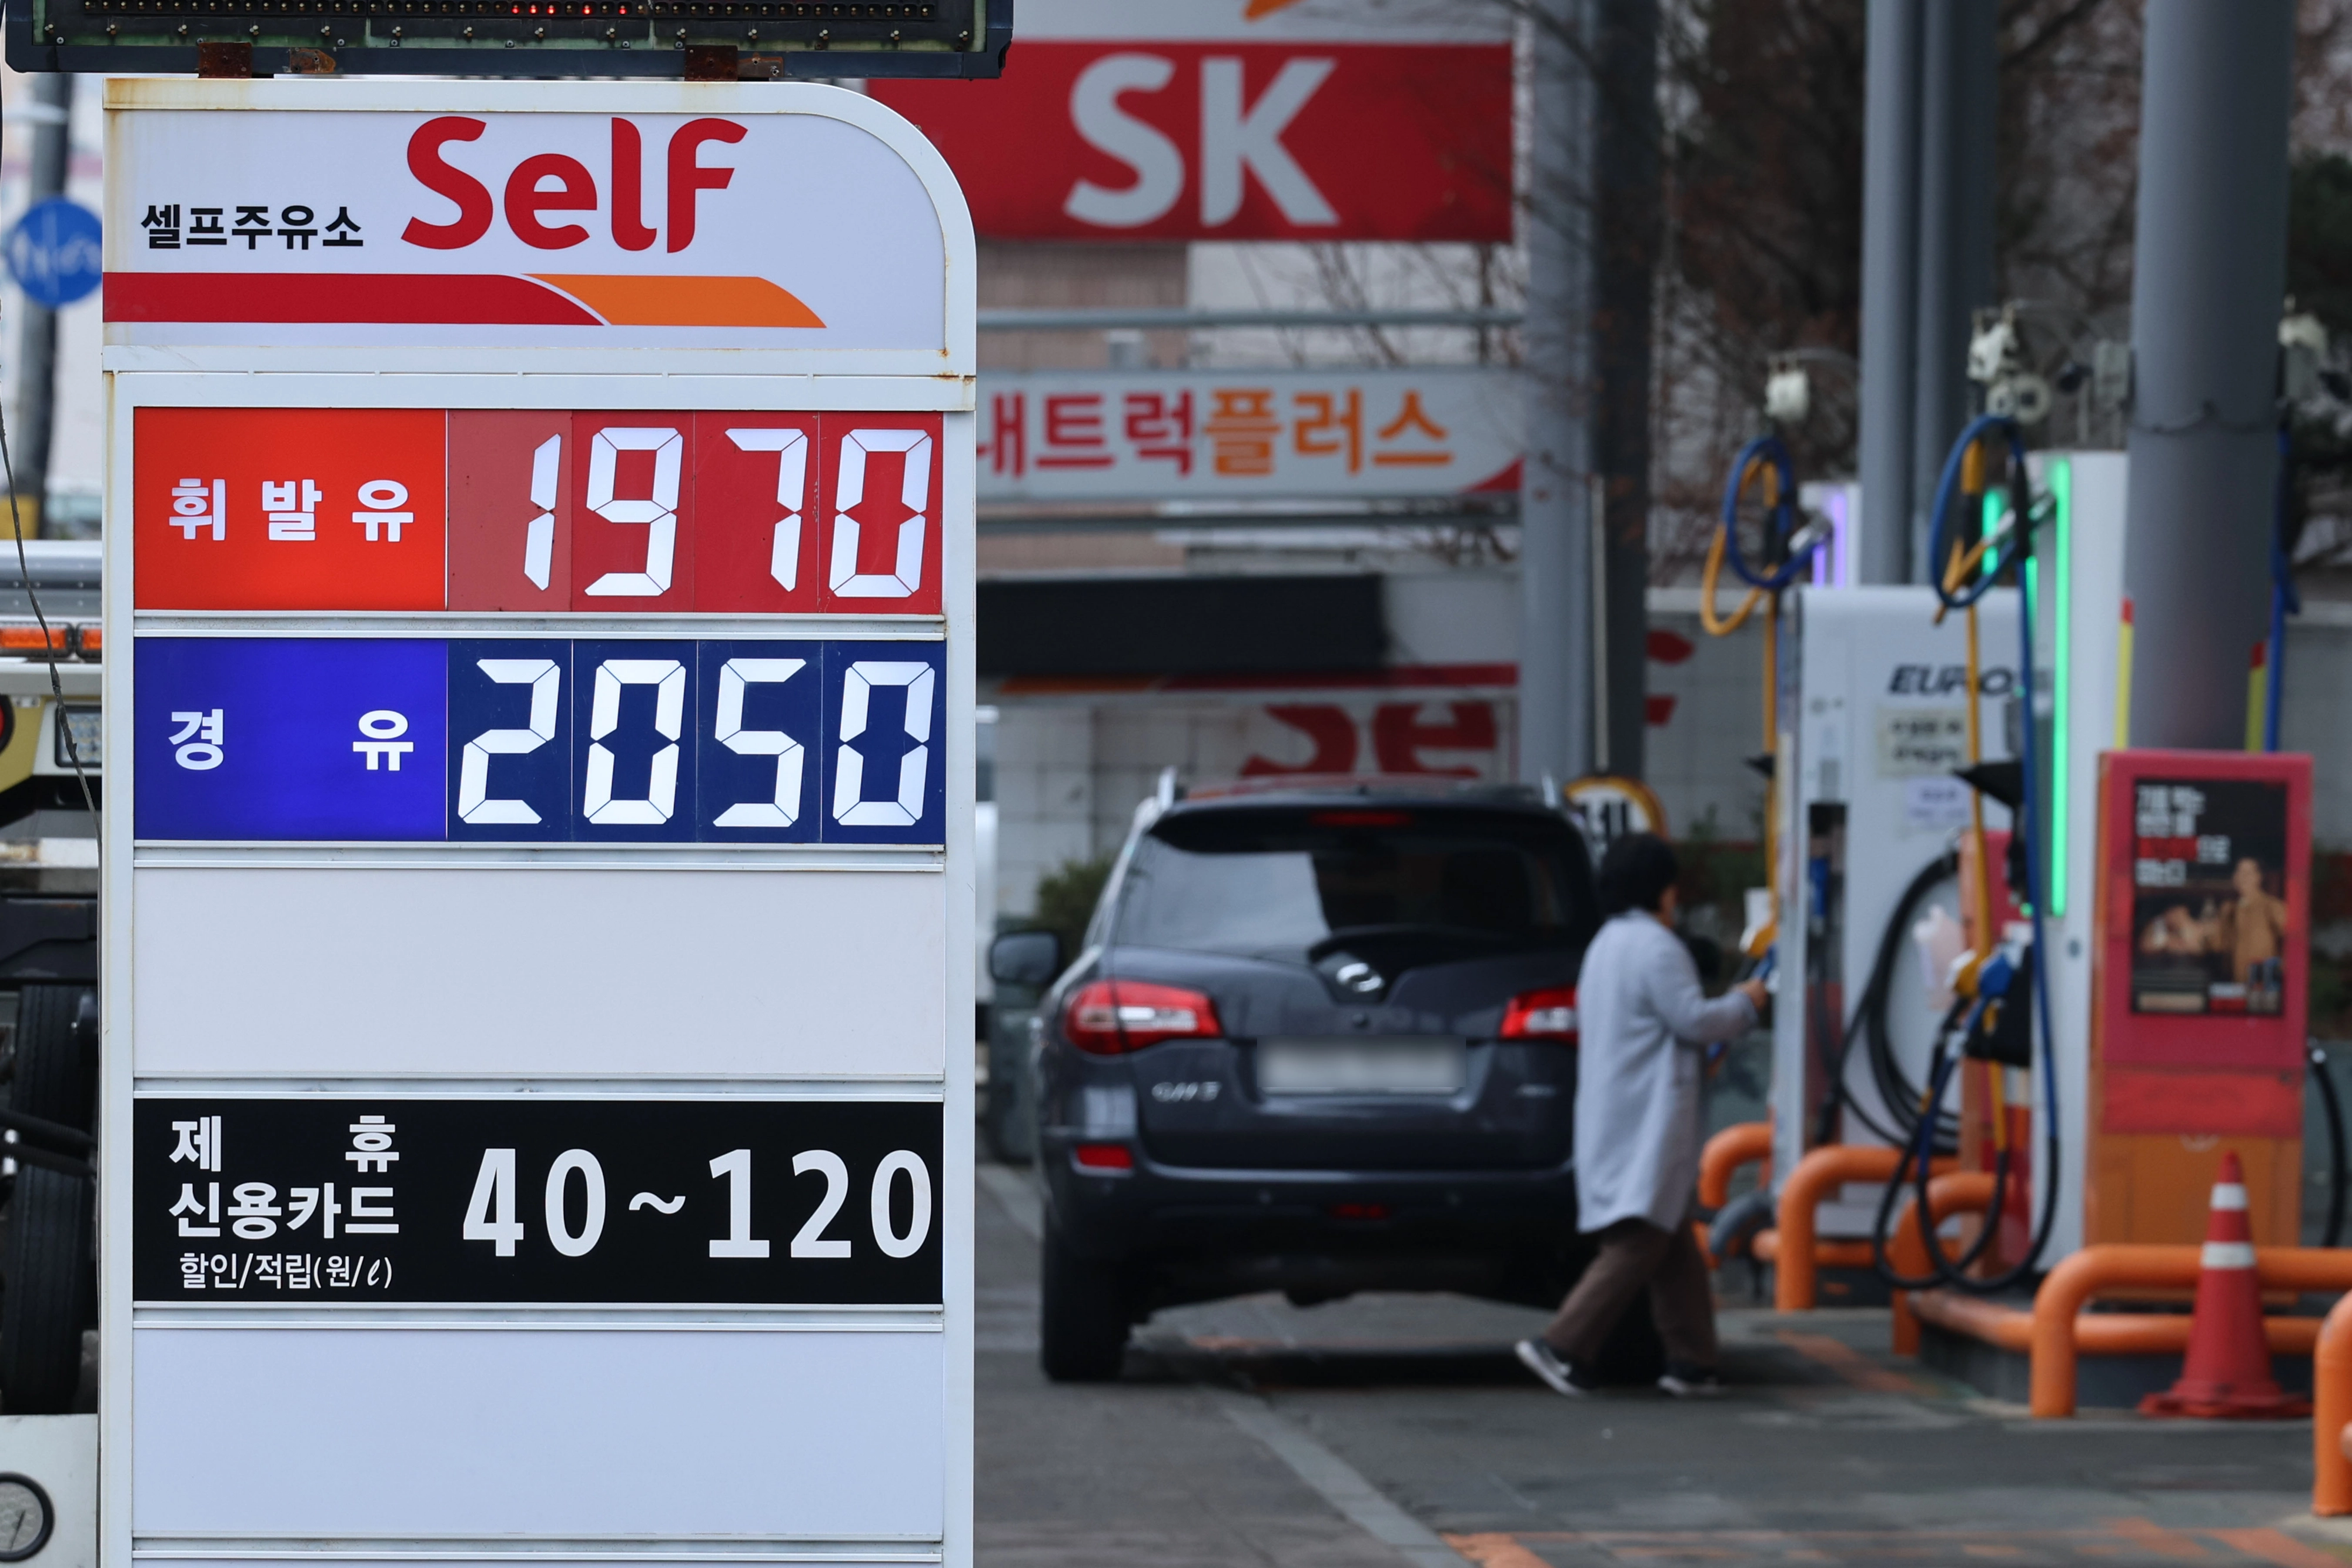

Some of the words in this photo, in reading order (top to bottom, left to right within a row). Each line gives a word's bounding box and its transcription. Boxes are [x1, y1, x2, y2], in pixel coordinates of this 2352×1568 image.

[402, 116, 747, 253] Self
[1065, 53, 1339, 228] SK
[141, 205, 363, 250] 셀프주유소
[523, 427, 933, 598] 1970
[457, 658, 935, 828] 2050
[169, 1182, 399, 1239] 신용카드
